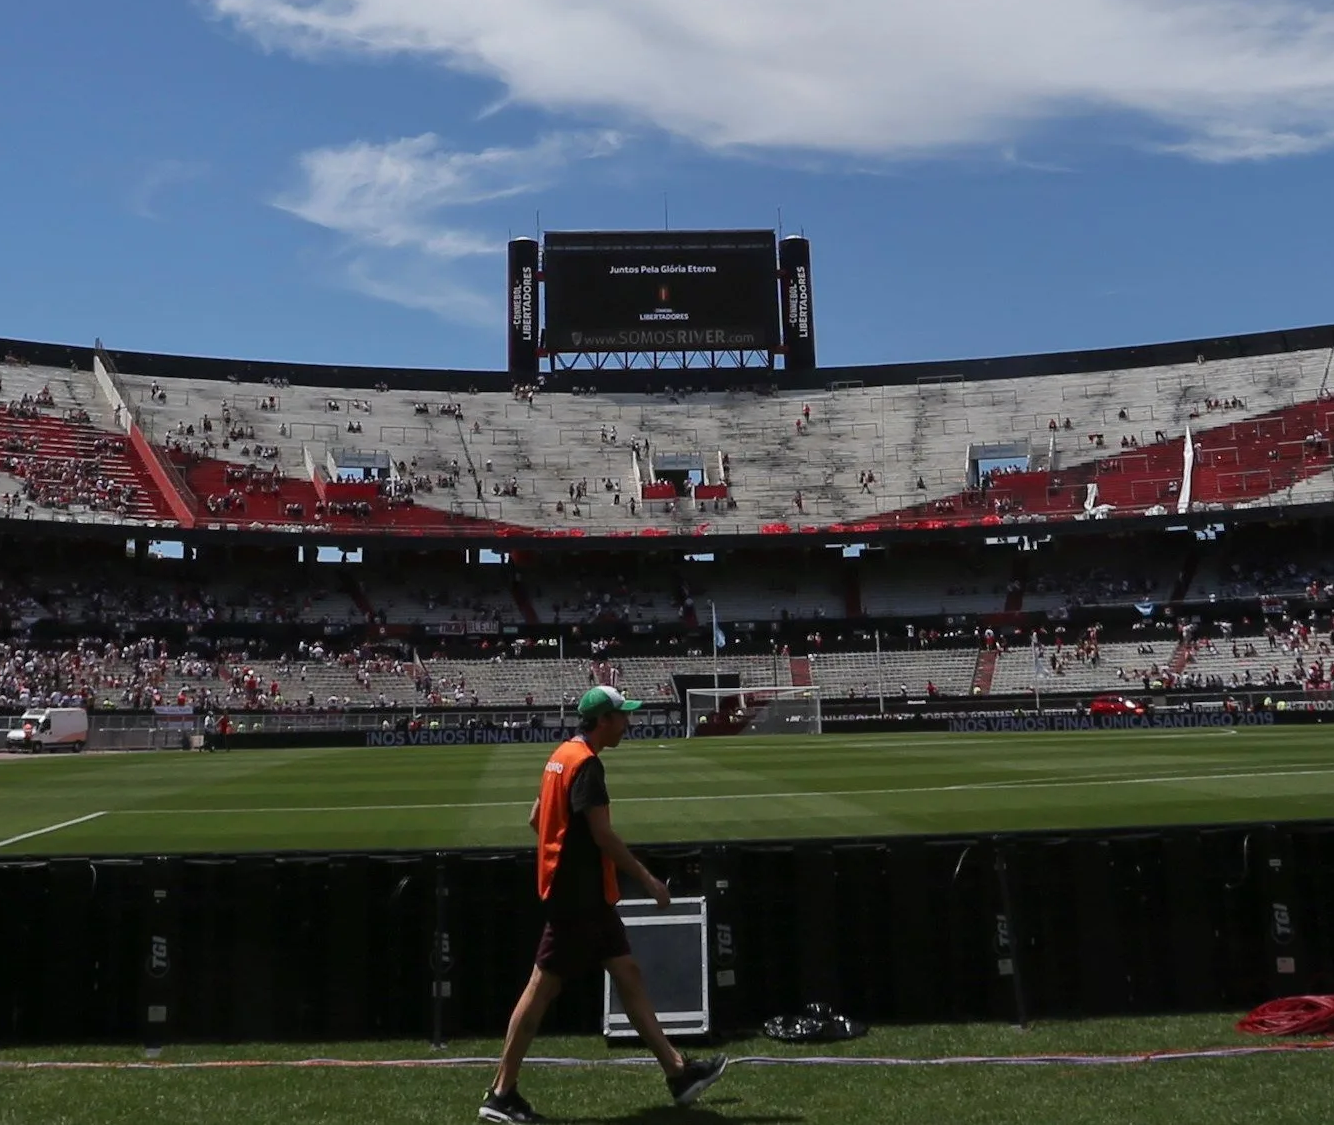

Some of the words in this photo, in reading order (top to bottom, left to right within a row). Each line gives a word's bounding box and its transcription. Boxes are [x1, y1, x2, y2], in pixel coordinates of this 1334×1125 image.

[609, 266, 639, 275] Juntos
[640, 265, 660, 274] Pela
[661, 264, 686, 274] Glória
[687, 264, 717, 273] Eterna
[522, 266, 532, 341] LIBERTADORES
[639, 313, 689, 321] LIBERTADORES
[796, 266, 808, 338] LIBERTADORES
[584, 329, 754, 346] www.SOMOSRIVER.com
[366, 730, 406, 746] ¡NOS
[408, 729, 470, 745] VEMOS!
[473, 727, 519, 744] FINAL
[990, 717, 1051, 731] VEMOS!
[1055, 716, 1099, 730] FINAL
[1156, 713, 1234, 727] SANTIAGO
[1238, 711, 1274, 726] 2019
[996, 913, 1010, 947] TGI
[1272, 902, 1291, 935] TGI
[152, 934, 167, 969] TGI
[717, 922, 733, 956] TGI
